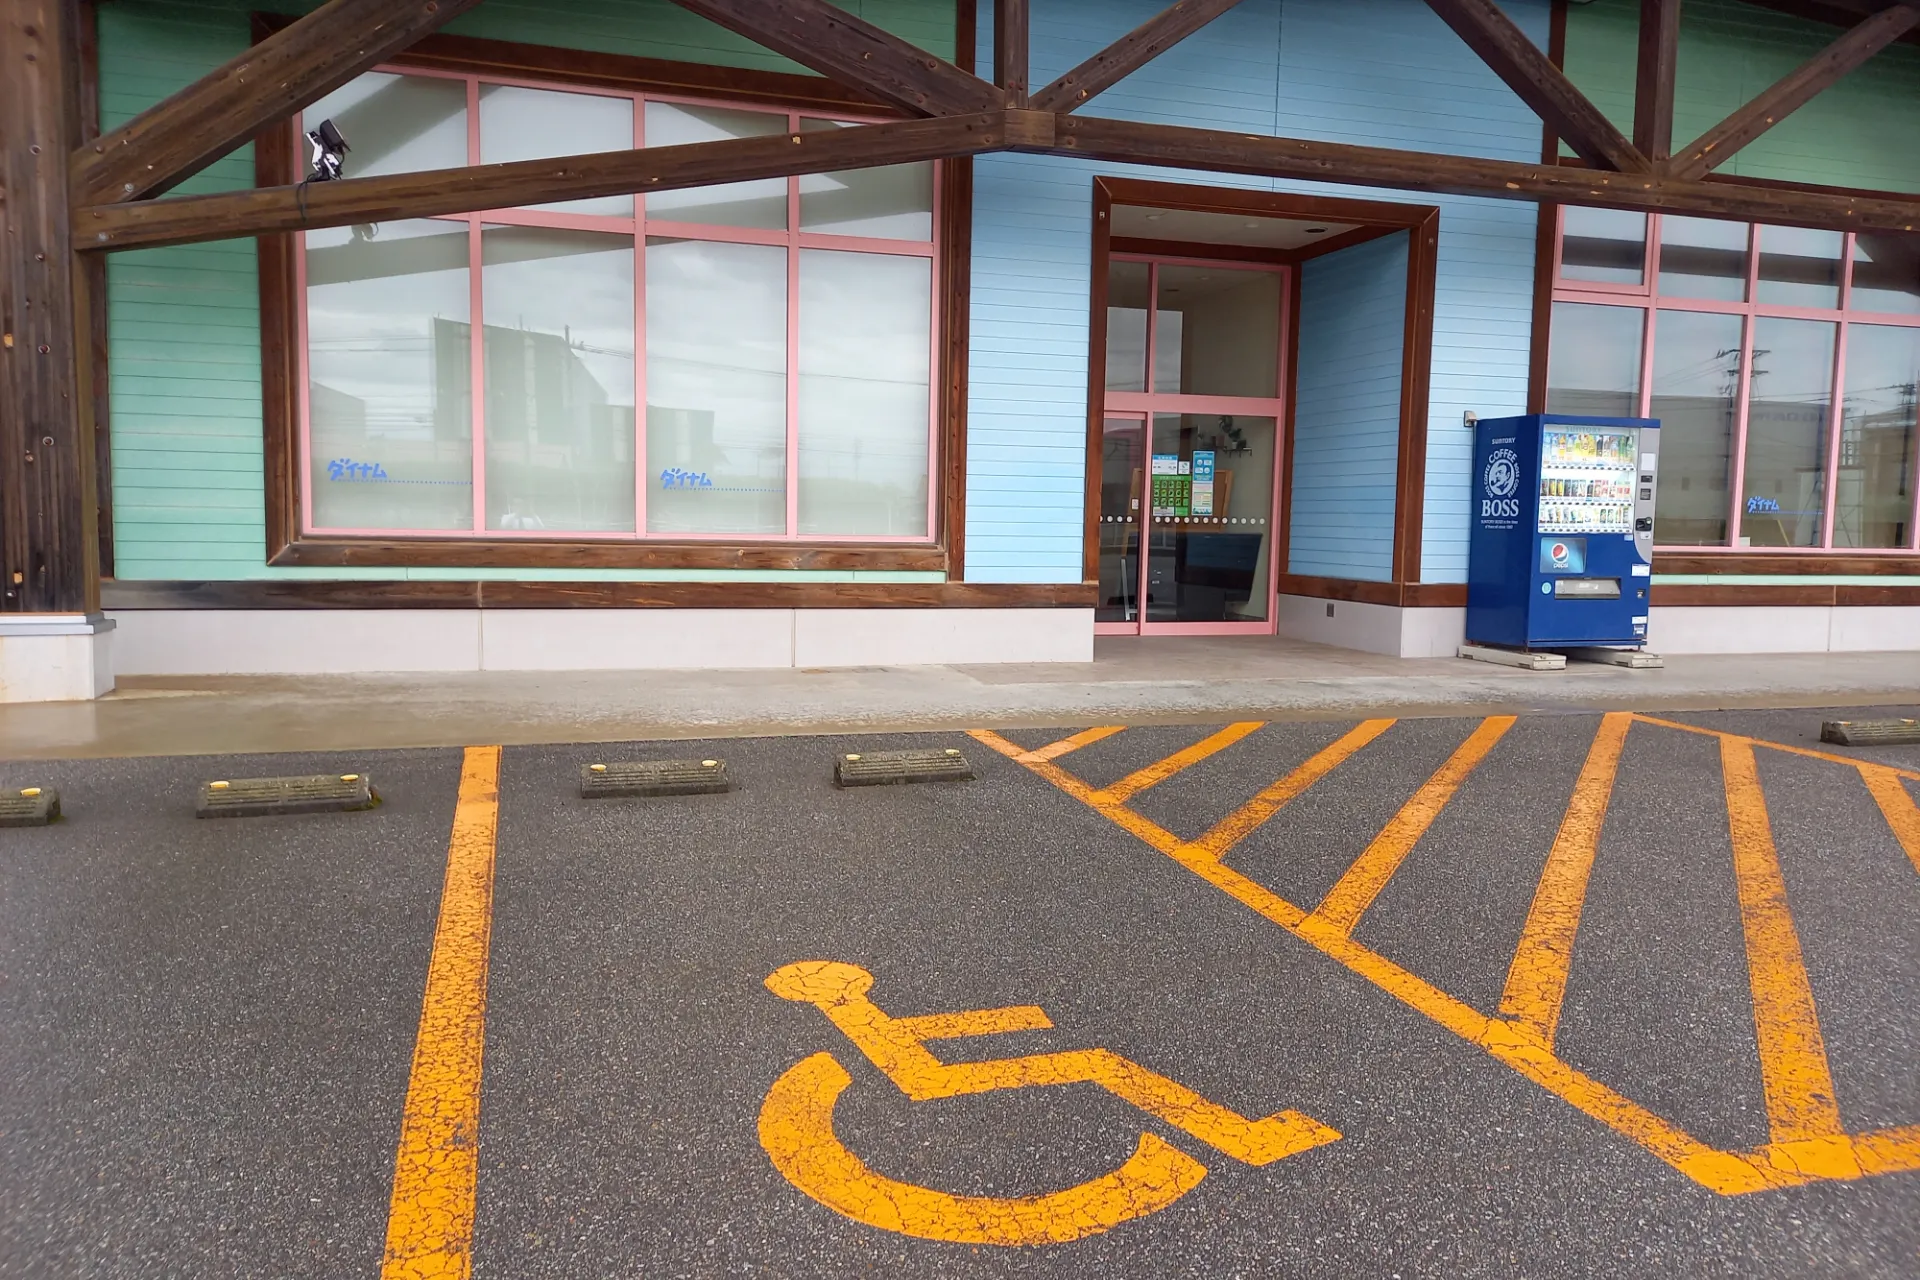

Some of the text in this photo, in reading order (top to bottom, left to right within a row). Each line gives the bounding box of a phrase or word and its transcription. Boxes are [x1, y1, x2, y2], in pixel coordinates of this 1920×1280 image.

[1489, 448, 1517, 463] COFFEE
[327, 458, 388, 481] ダイナム
[660, 468, 712, 489] ダイナム
[1481, 499, 1519, 517] BOSS
[1747, 496, 1780, 513] ダイナム
